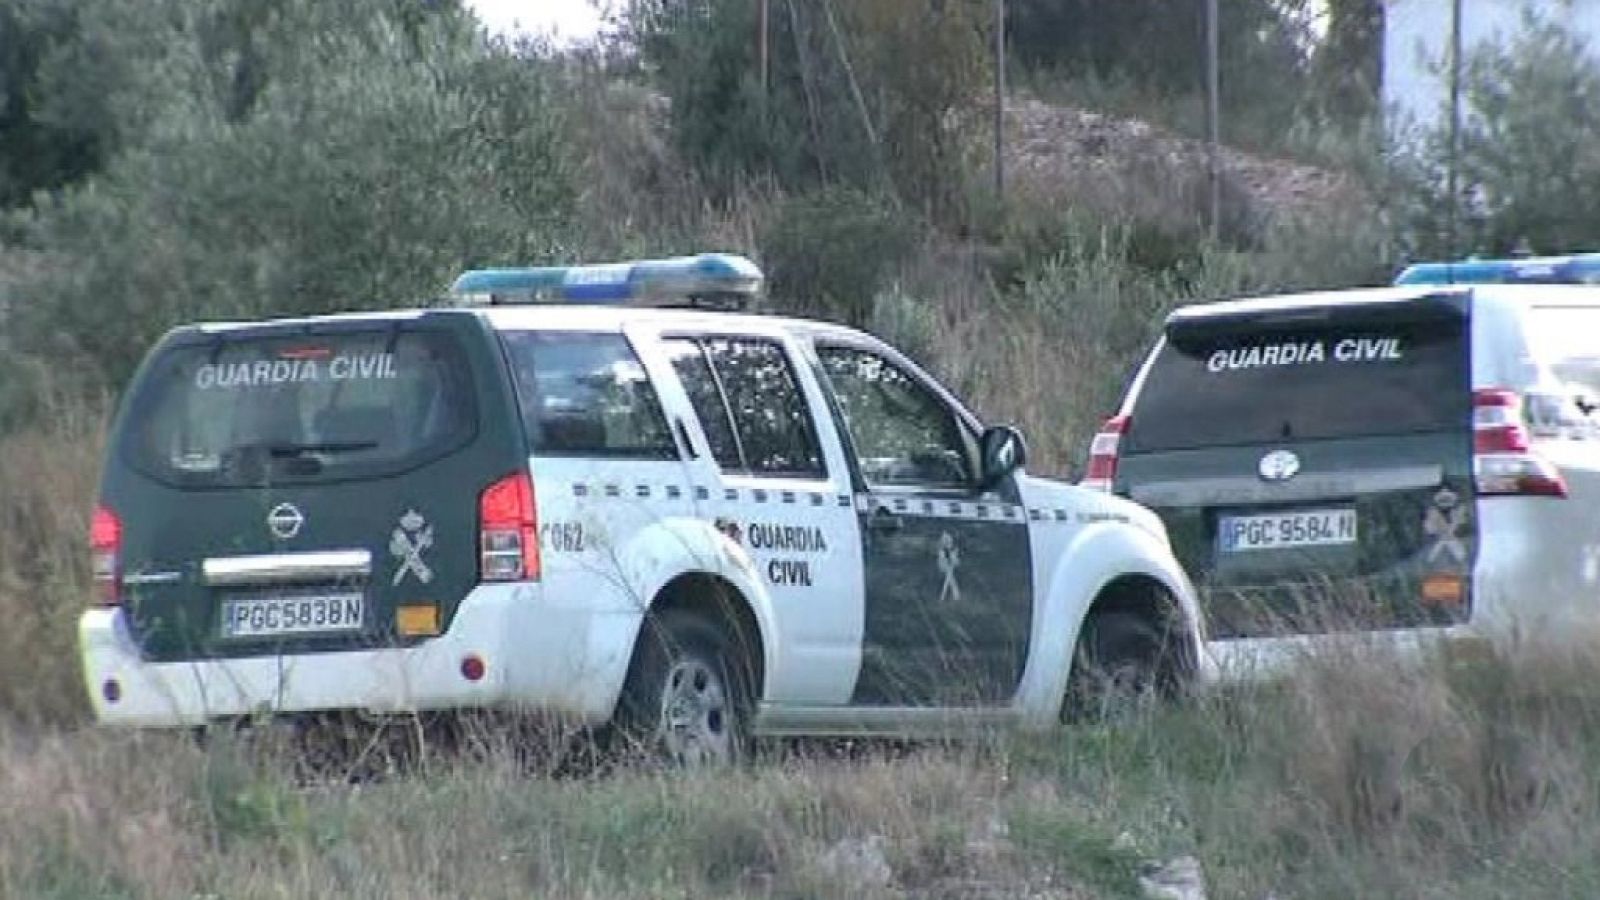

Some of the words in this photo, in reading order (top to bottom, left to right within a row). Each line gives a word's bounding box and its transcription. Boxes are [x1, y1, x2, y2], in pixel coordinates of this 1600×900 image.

[196, 359, 319, 389] GUARDIA
[329, 353, 397, 379] CIVIL
[1208, 341, 1325, 373] GUARDIA
[1334, 338, 1402, 361] CIVIL
[749, 523, 827, 552] GUARDIA
[768, 561, 812, 587] CIVIL
